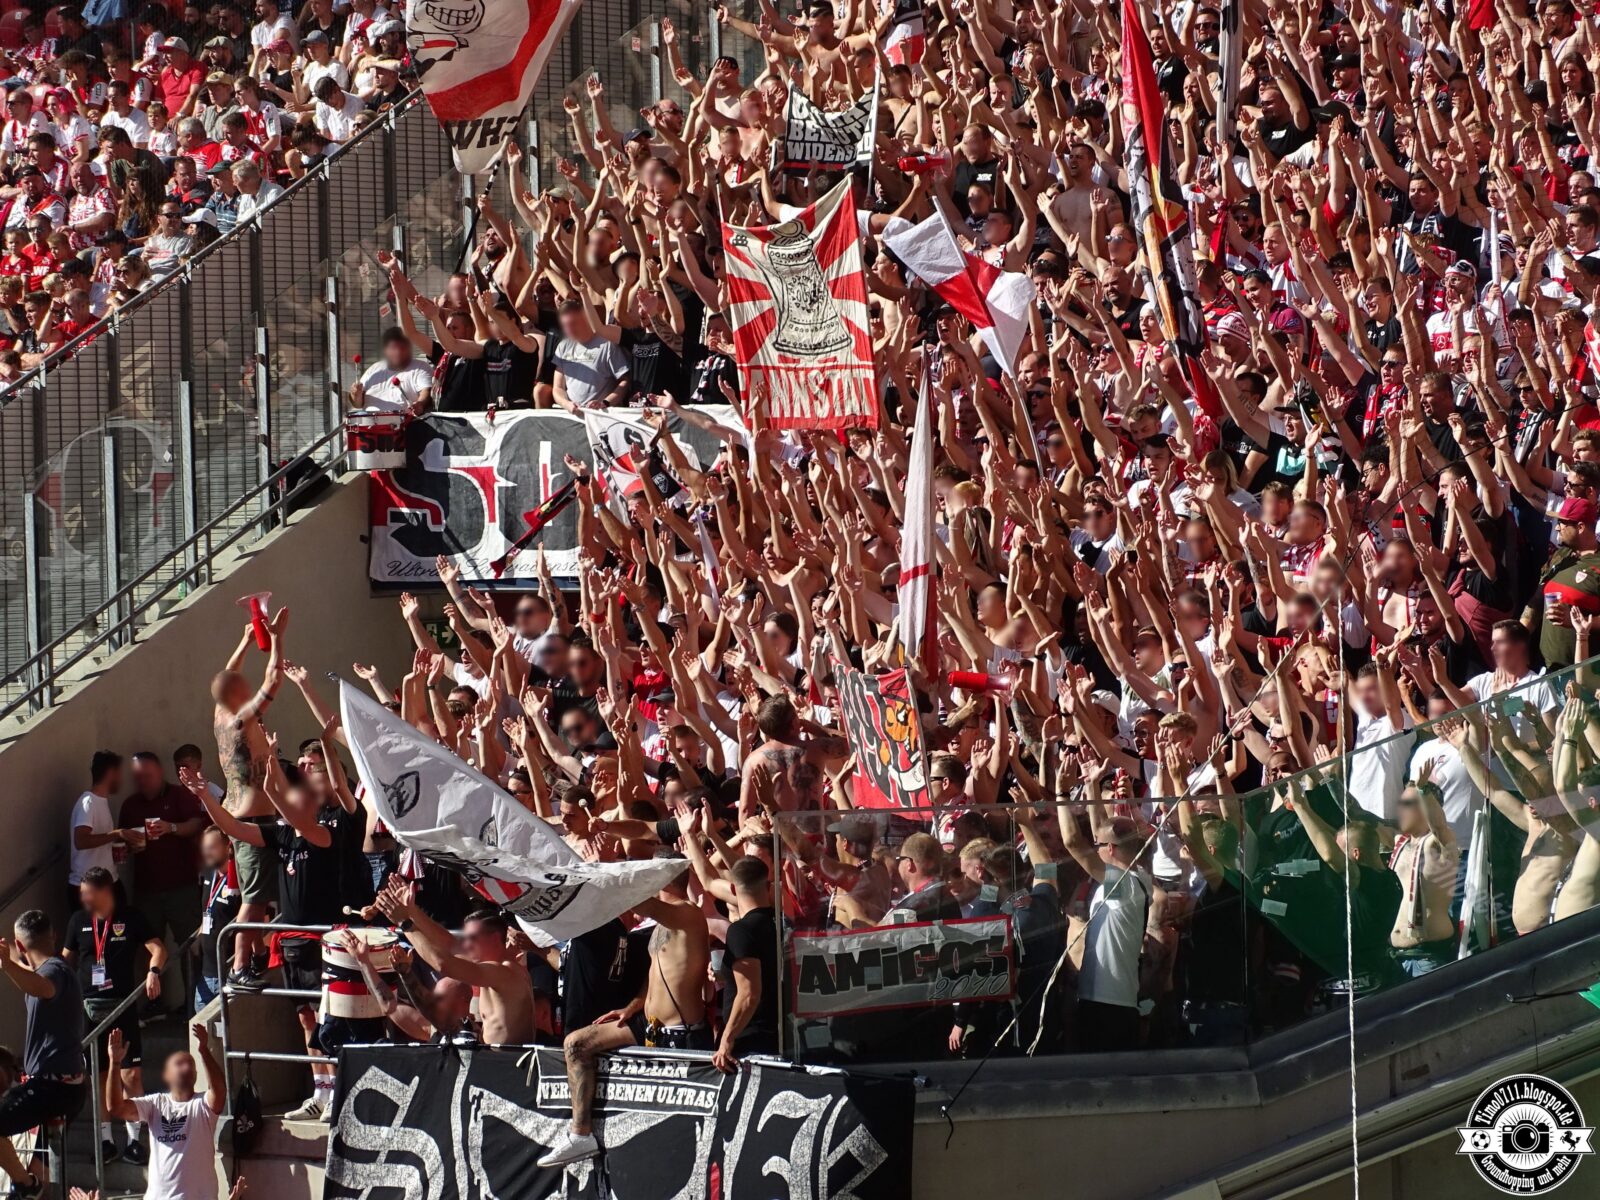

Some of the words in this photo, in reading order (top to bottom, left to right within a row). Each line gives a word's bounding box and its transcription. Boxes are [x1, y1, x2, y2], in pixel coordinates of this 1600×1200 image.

[929, 972, 1010, 1001] 2010
[656, 1086, 716, 1109] ULTRAS
[157, 1133, 187, 1143] adidas
